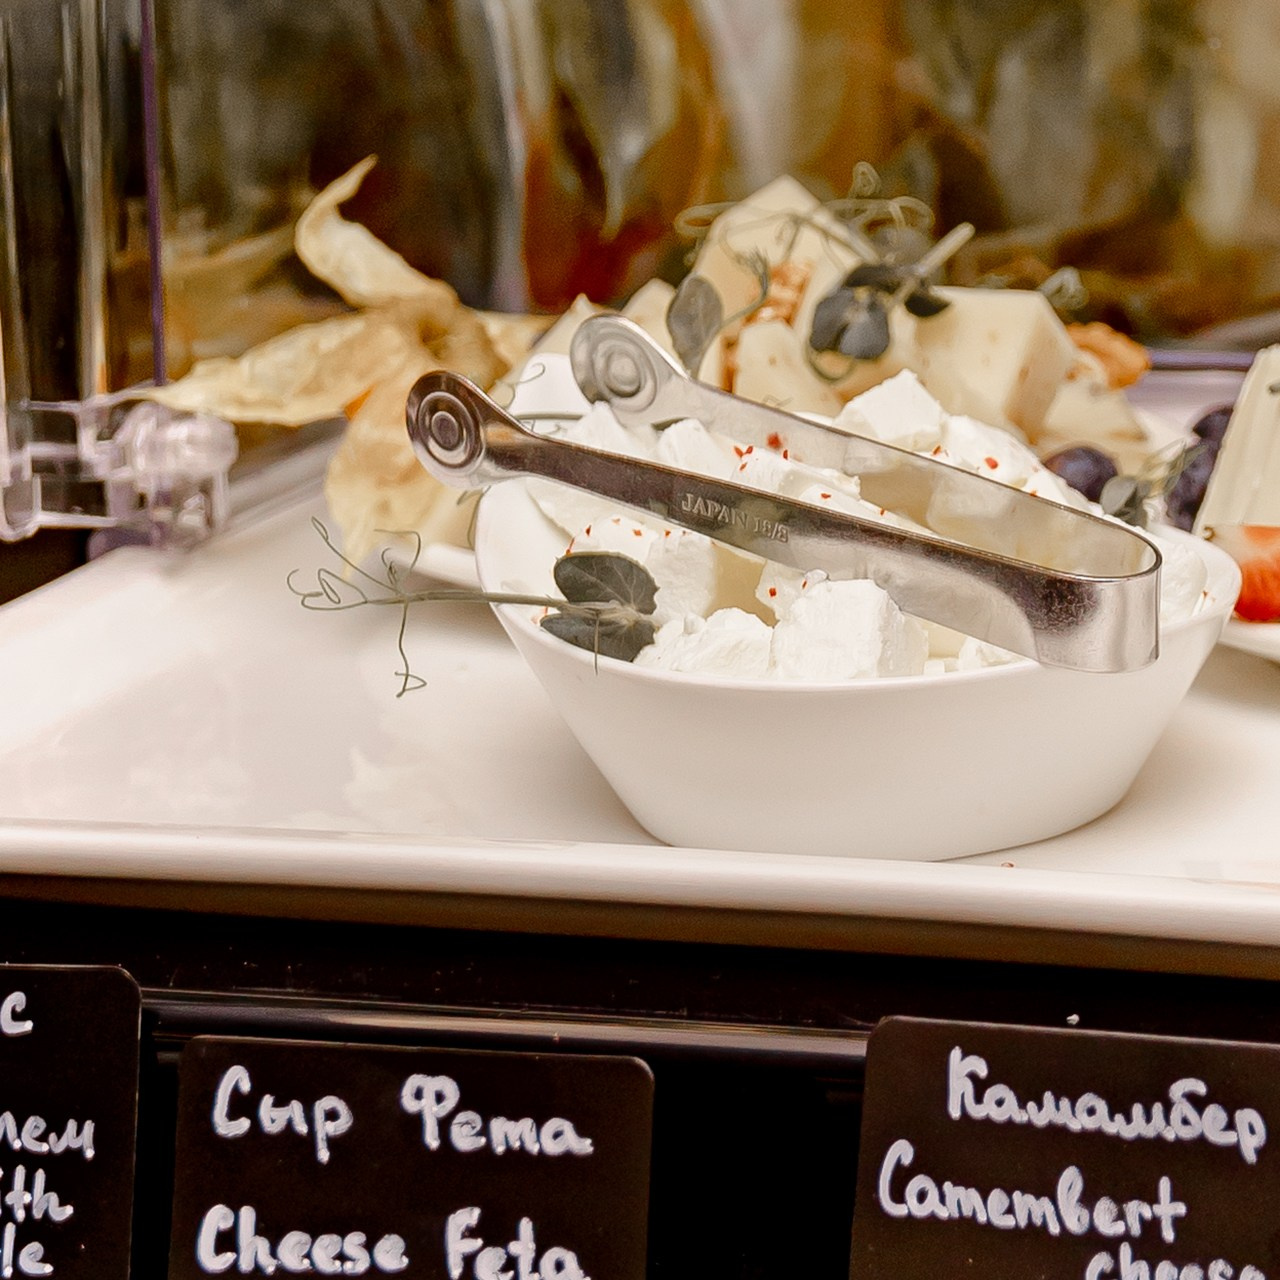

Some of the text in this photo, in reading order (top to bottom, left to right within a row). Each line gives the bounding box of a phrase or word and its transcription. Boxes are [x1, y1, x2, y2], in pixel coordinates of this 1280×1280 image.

[682, 493, 747, 529] JAPAN
[213, 1065, 594, 1163] Сыр Фета
[947, 1045, 1267, 1165] Камамбер
[198, 1203, 409, 1275] Cheese
[878, 1137, 1187, 1244] Camembert
